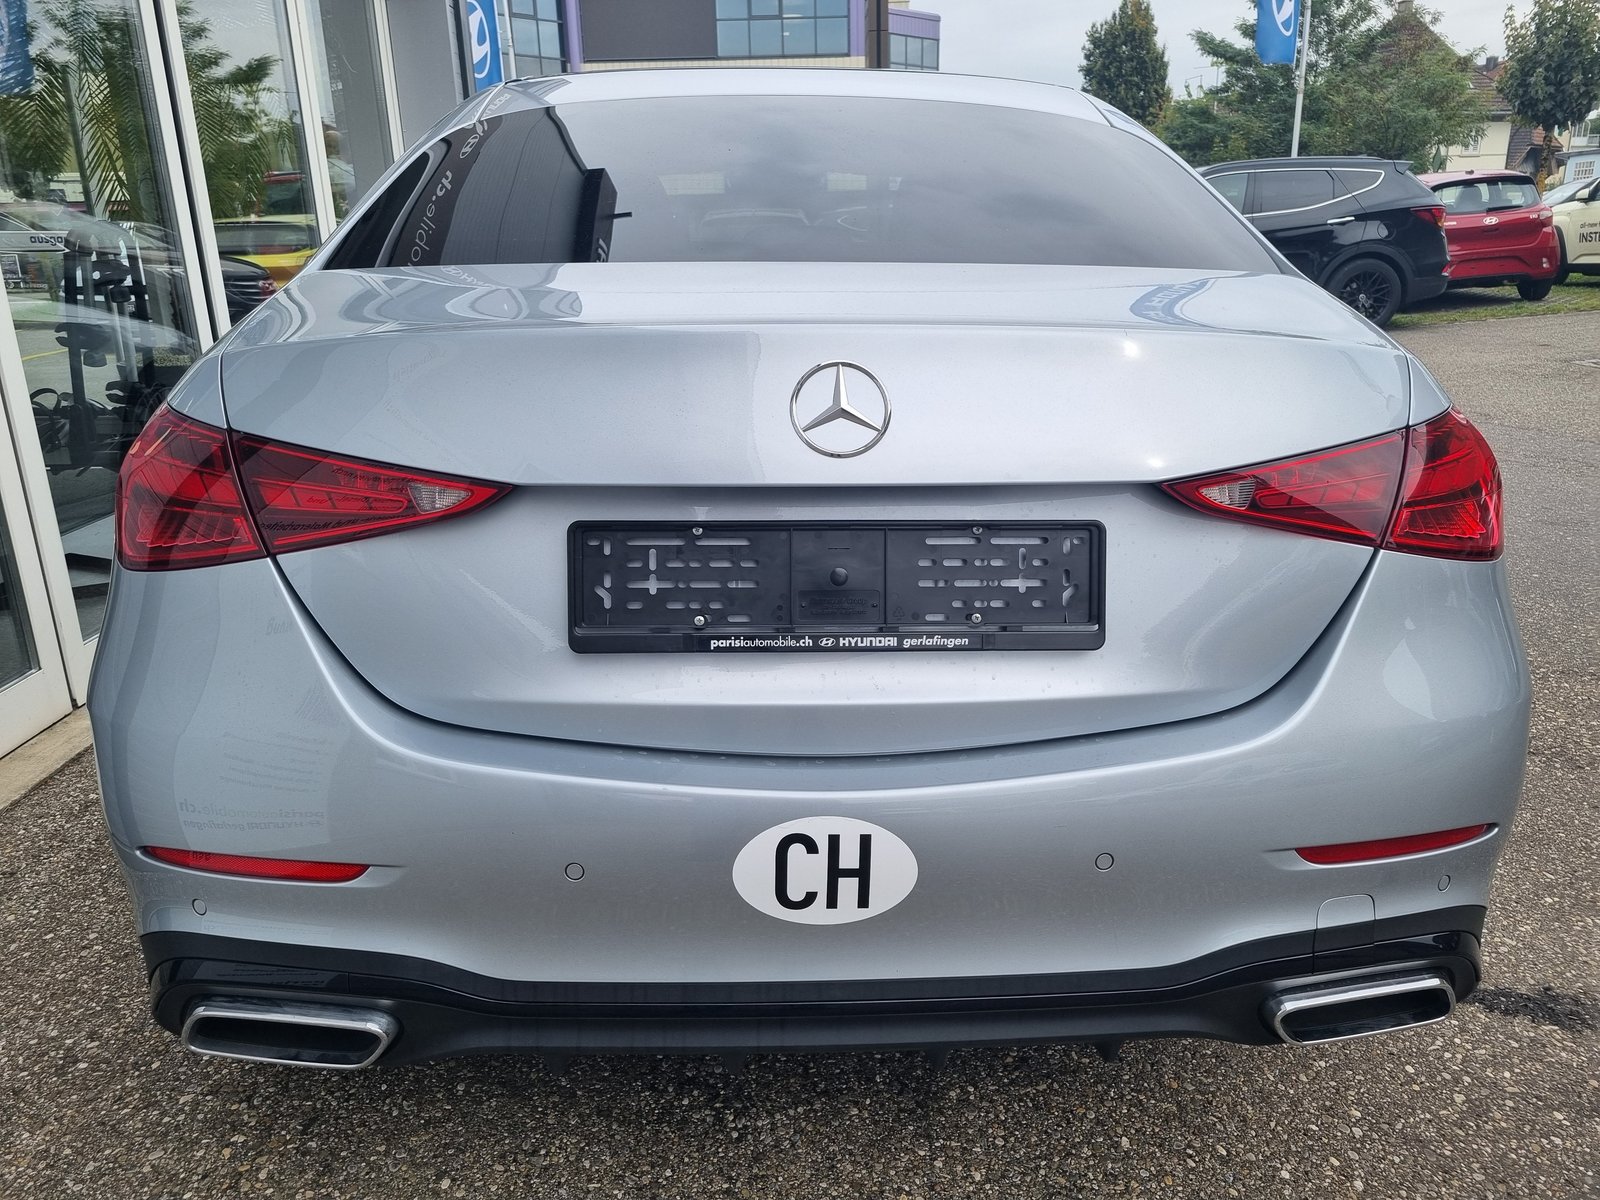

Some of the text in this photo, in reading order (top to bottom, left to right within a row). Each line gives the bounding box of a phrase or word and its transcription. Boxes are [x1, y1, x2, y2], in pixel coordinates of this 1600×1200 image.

[710, 635, 969, 650] parisiautomobile.ch HYUNDAI gerlafingen
[775, 832, 872, 910] CH
